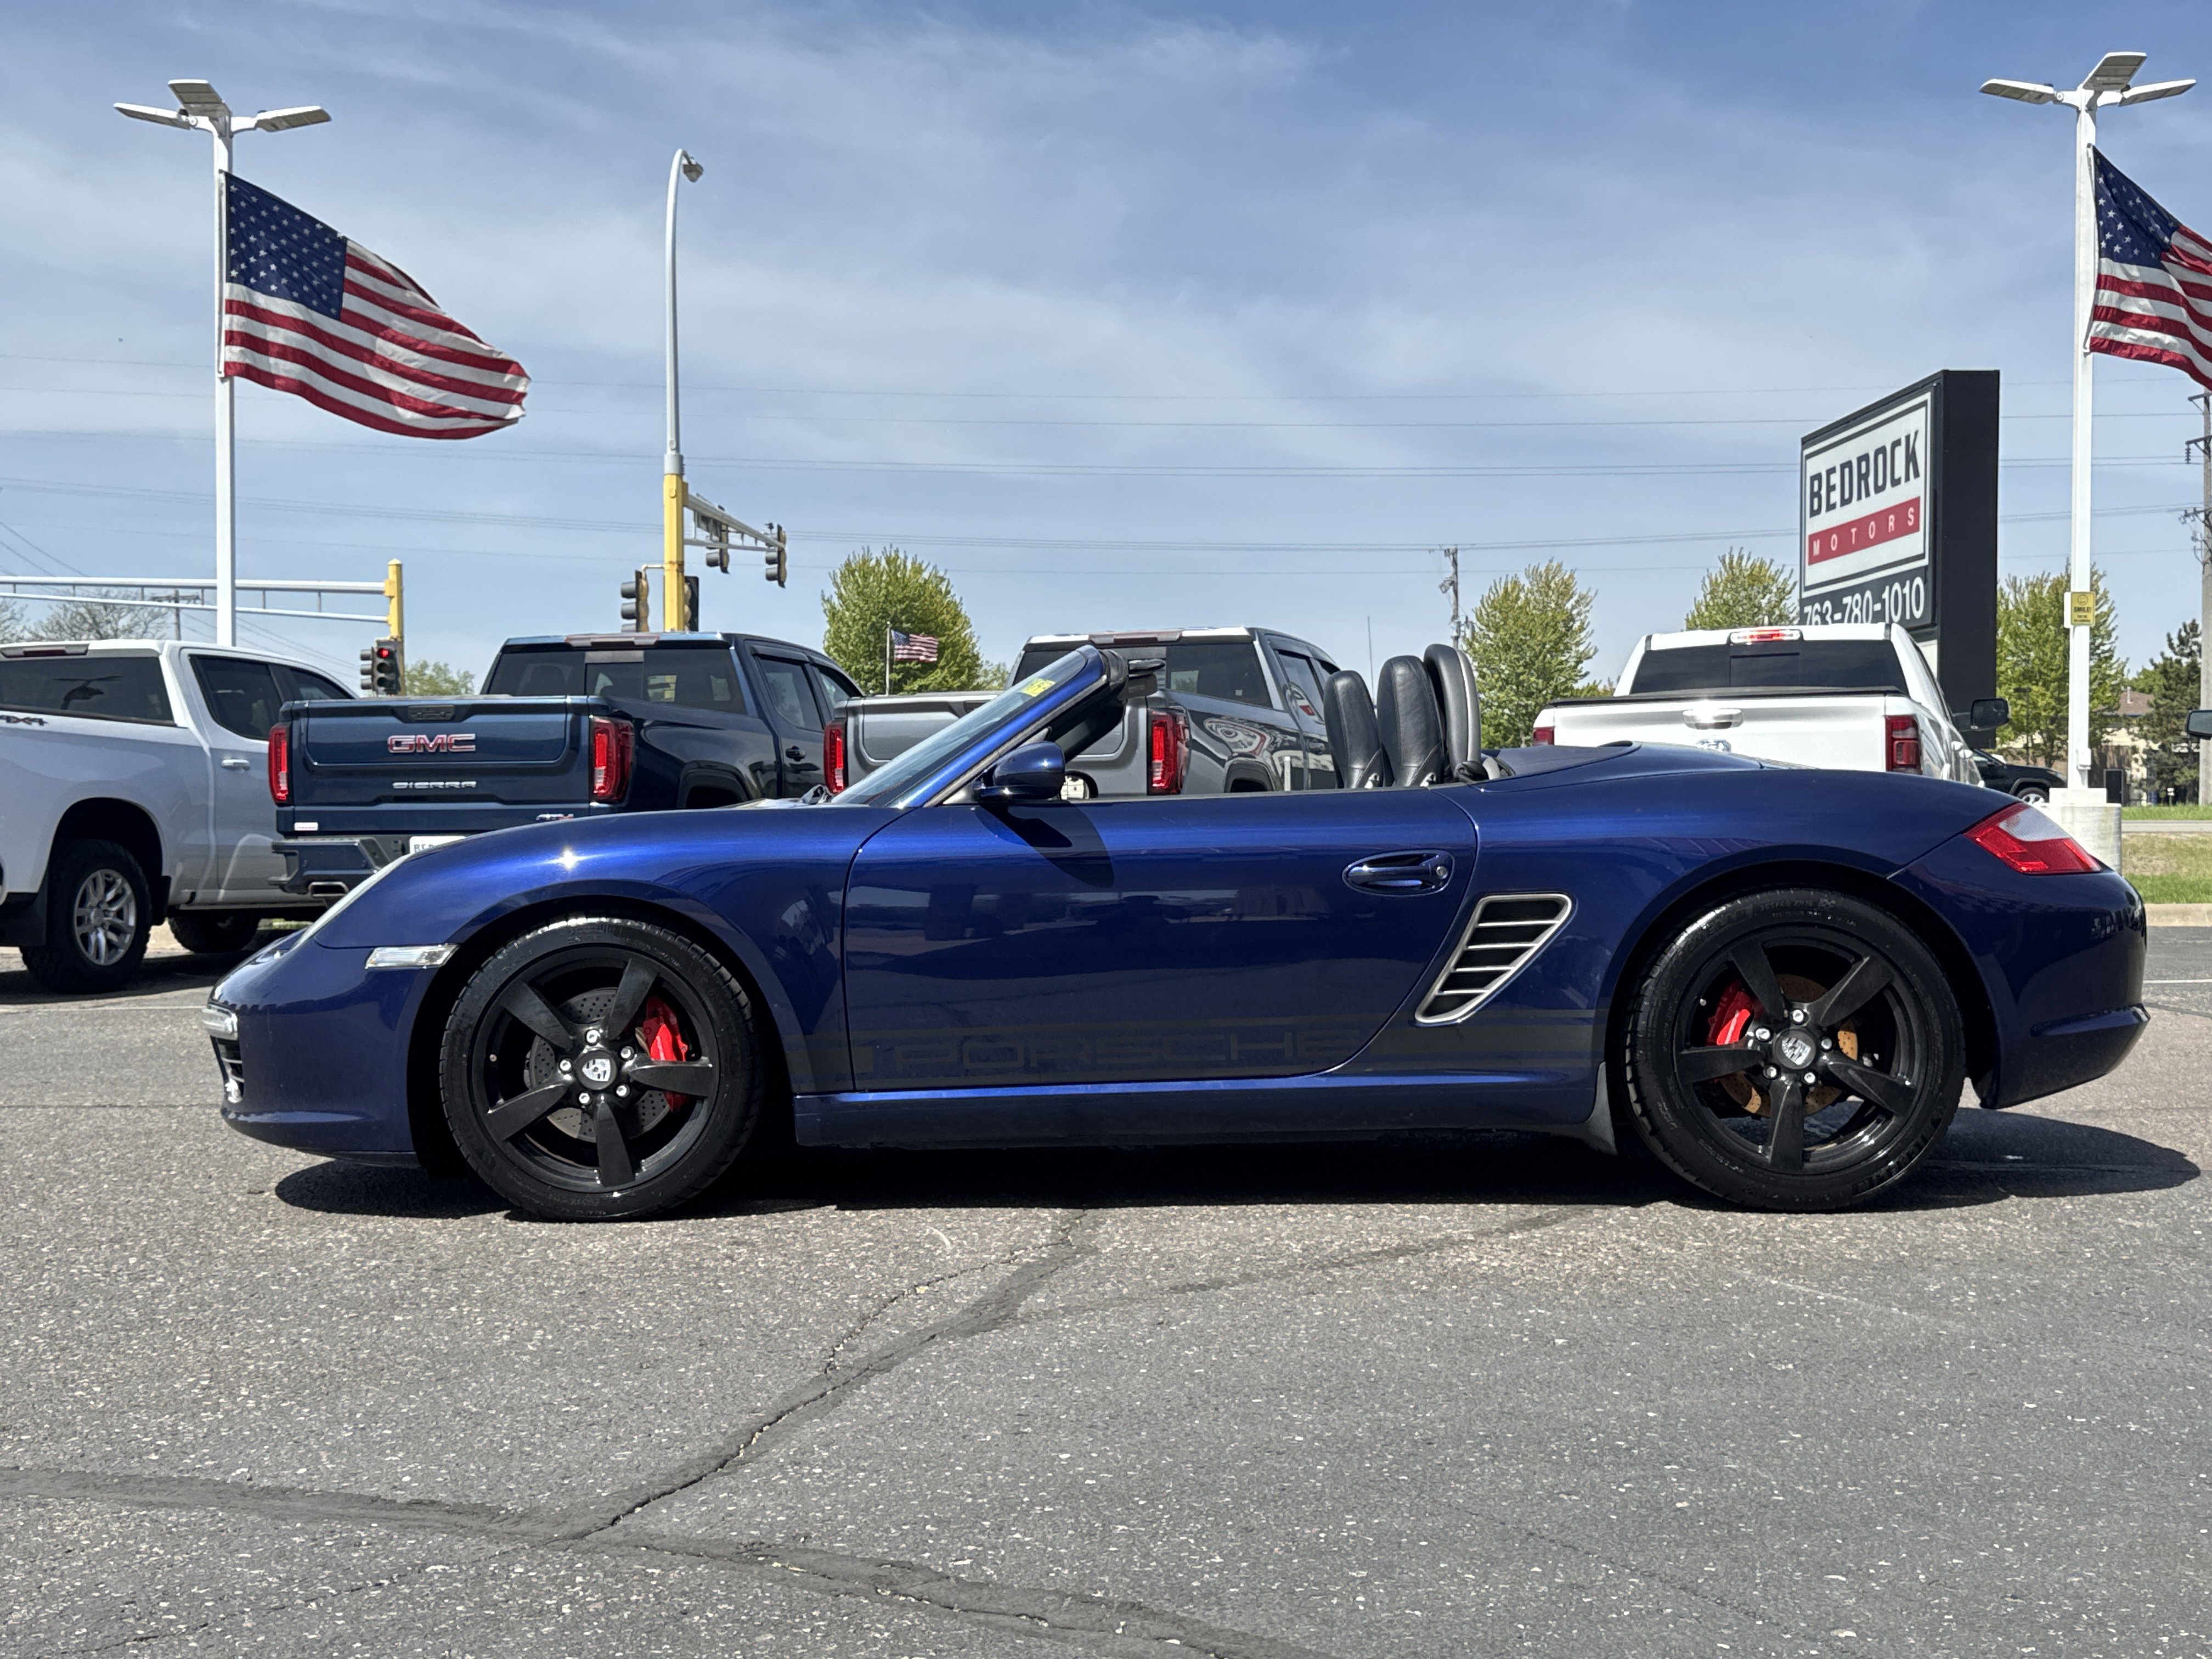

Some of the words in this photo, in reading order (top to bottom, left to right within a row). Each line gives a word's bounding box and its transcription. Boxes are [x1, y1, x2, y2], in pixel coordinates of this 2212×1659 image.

[1809, 430, 1920, 518] BEDROCK
[1813, 507, 1915, 556] MOTORS
[1804, 576, 1925, 625] 763-780-1010
[387, 733, 476, 753] GMC
[392, 781, 477, 789] SIERRA
[895, 1029, 1360, 1071] PORSCHE
